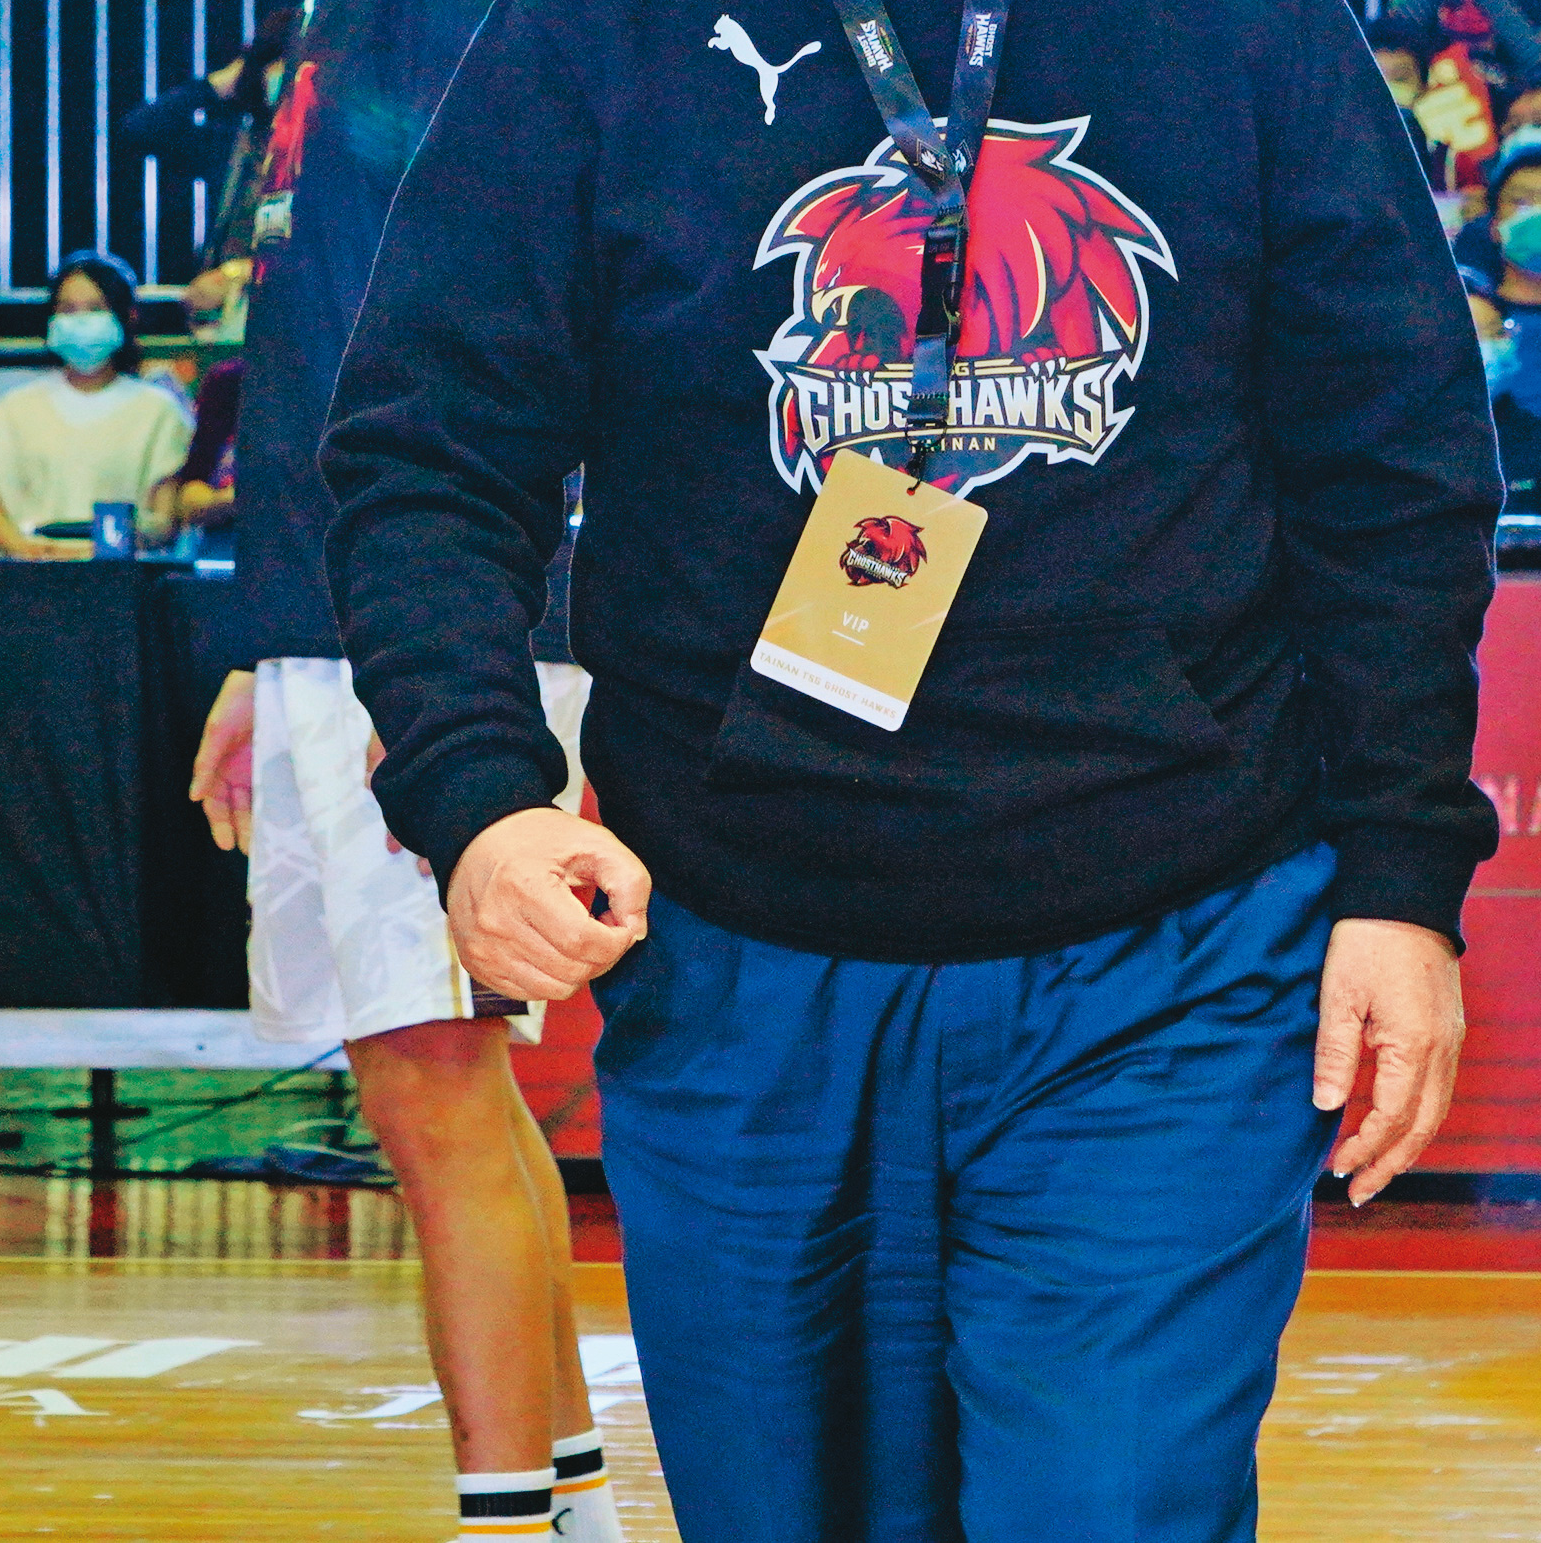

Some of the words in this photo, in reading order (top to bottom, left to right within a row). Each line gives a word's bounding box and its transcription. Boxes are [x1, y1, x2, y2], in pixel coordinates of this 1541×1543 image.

[859, 19, 894, 74] HAWKS
[968, 13, 992, 67] HAWKS
[787, 372, 938, 456] GHOS
[842, 610, 870, 633] VIP
[759, 652, 800, 676] TAINAN
[802, 671, 822, 686] TSG
[824, 681, 859, 701] GHOST
[861, 697, 898, 719] HAWKS
